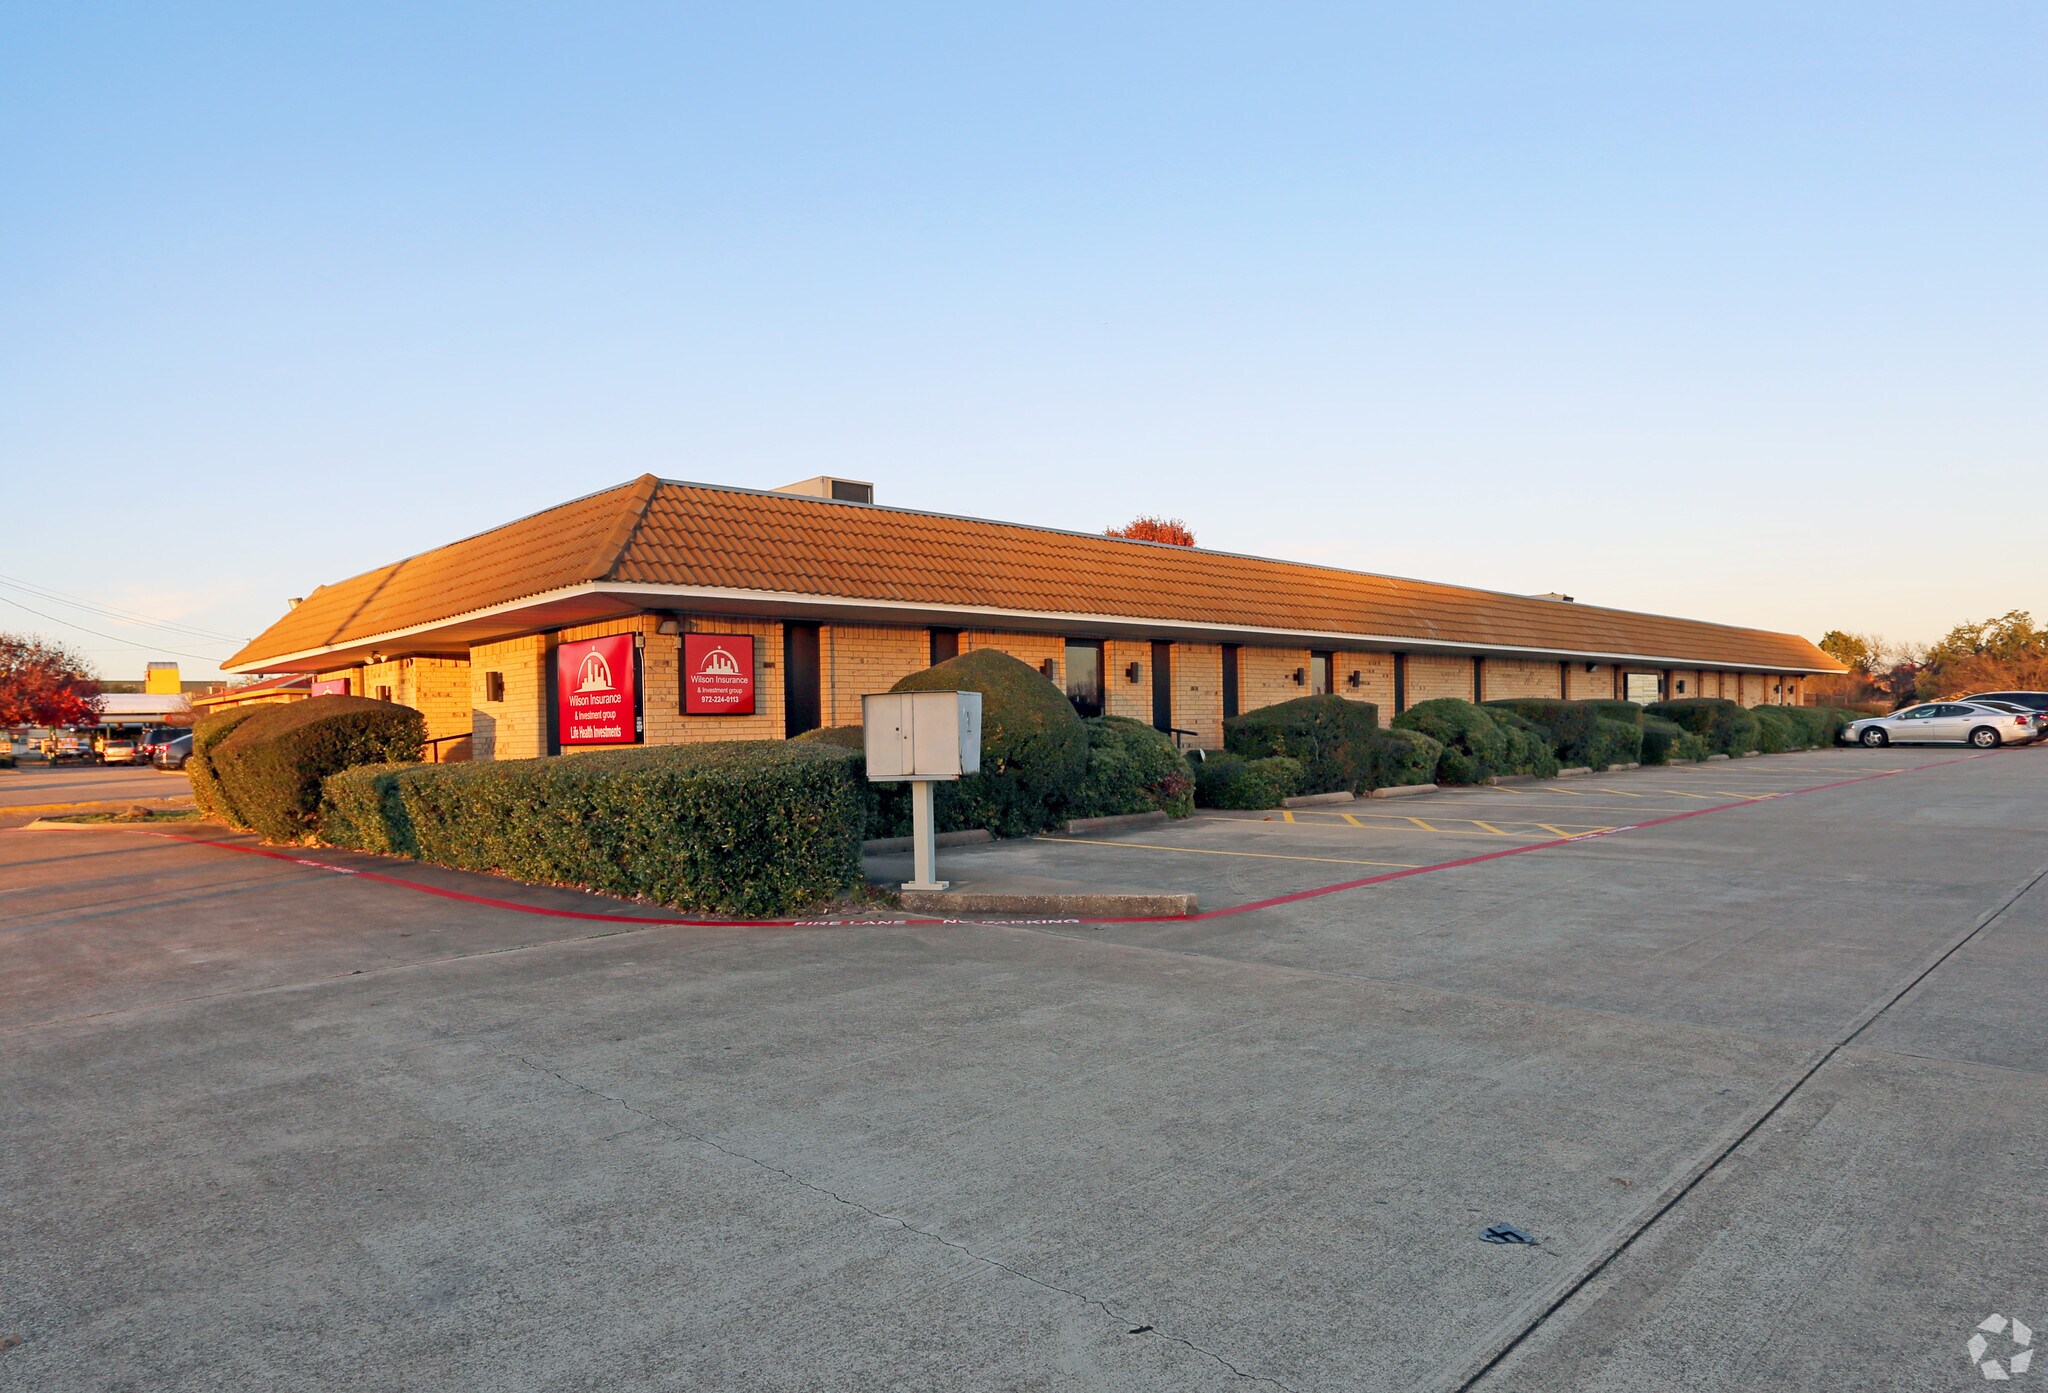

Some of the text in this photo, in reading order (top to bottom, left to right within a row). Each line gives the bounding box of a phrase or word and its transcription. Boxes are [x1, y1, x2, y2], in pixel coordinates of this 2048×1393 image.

[691, 675, 748, 684] Wilson Insurance
[569, 693, 621, 706] Wilson Insurance
[602, 711, 616, 721] group
